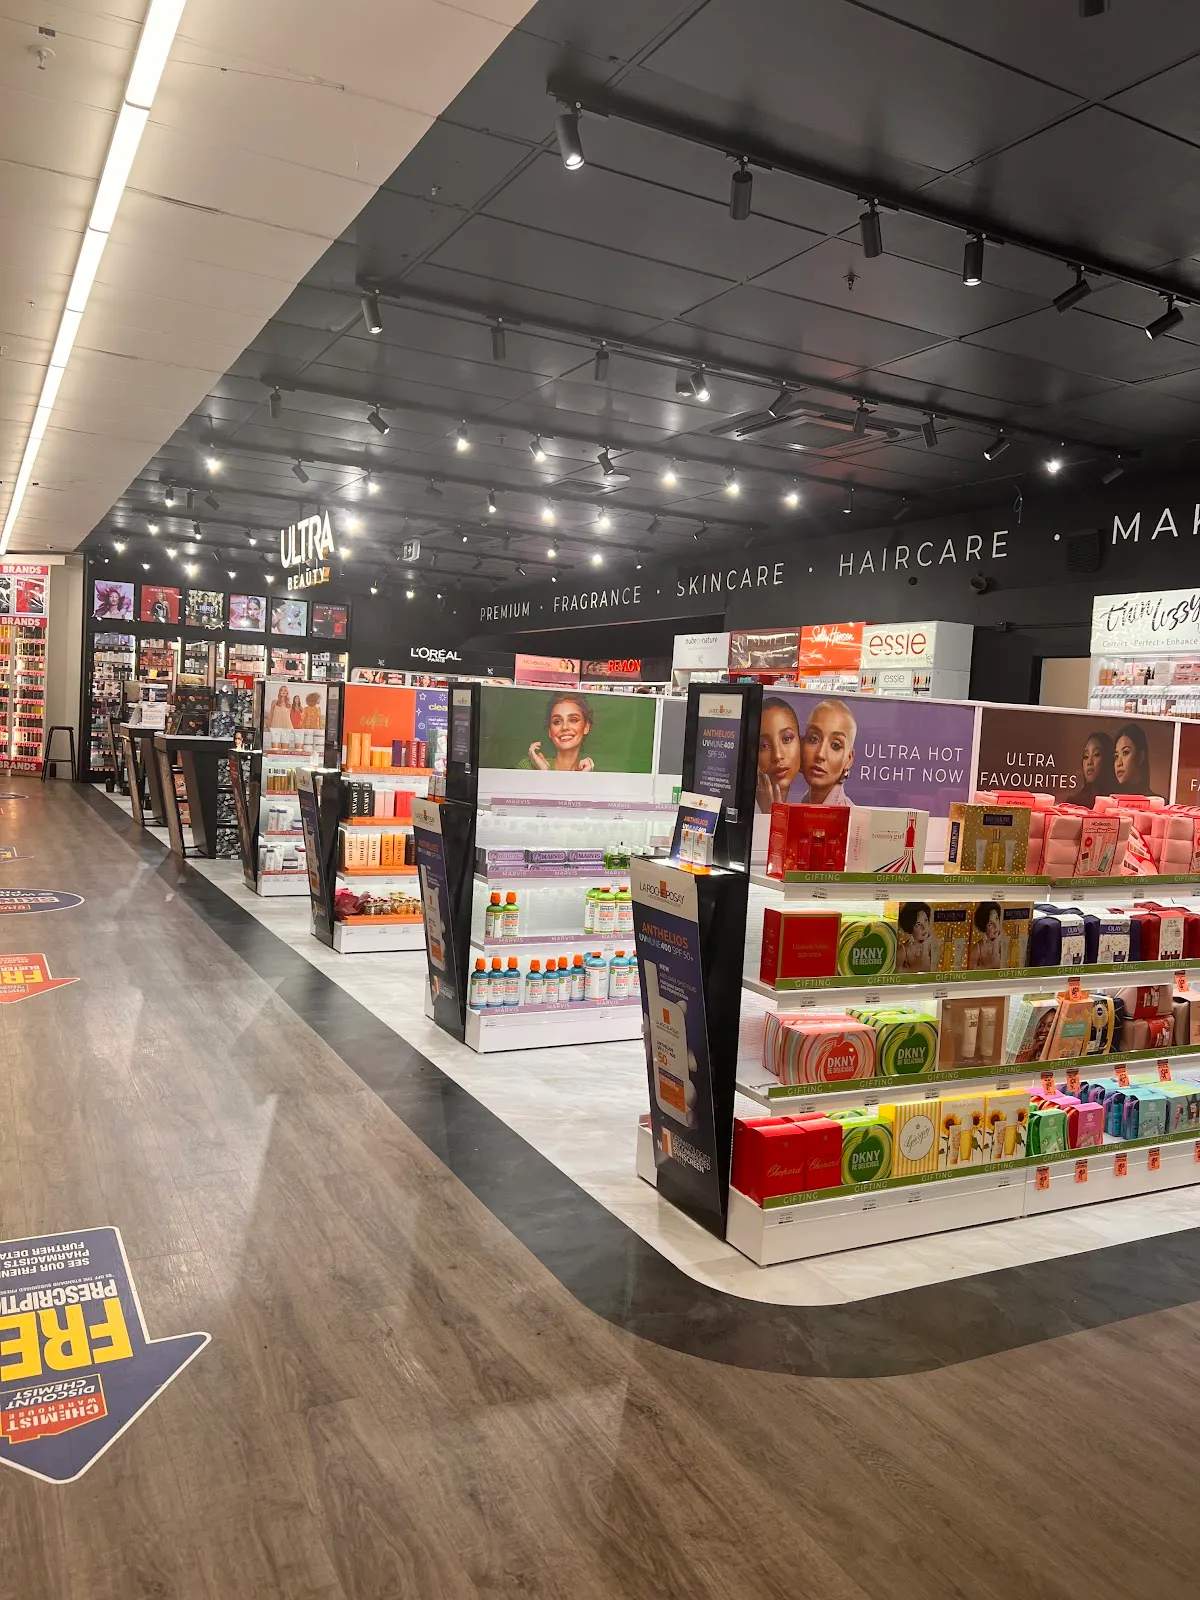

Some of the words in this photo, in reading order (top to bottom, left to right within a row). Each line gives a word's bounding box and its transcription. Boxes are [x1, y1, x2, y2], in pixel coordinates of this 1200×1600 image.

[280, 510, 334, 569] ULTRA
[839, 530, 1009, 577] HAIRCARE
[3, 565, 41, 574] BRANDS
[288, 567, 326, 591] BEAUTY
[677, 562, 785, 597] SKINCARE
[553, 586, 641, 613] FRAGRANCE
[480, 601, 530, 621] PREMIUM
[1, 617, 41, 626] BRANDS
[869, 632, 927, 656] essie
[410, 647, 462, 661] L'ORÉAL
[607, 659, 641, 673] REVLON
[864, 743, 922, 761] ULTRA
[928, 746, 964, 762] HOT
[1006, 751, 1055, 769] ULTRA
[860, 767, 917, 782] RIGHT
[922, 768, 964, 783] NOW
[980, 771, 1077, 790] FAVOURITES
[805, 873, 840, 881] GIFTING
[876, 874, 910, 882] GIFTING
[943, 875, 975, 883] GIFTING
[1007, 876, 1036, 884] GIFTING
[641, 922, 689, 949] ANTHELIOS
[852, 947, 884, 959] DKNY
[0, 970, 43, 984] FR
[867, 976, 901, 984] GIFTING
[936, 973, 967, 981] GIFTING
[998, 970, 1028, 978] GIFTING
[795, 978, 832, 988] GIFTING
[898, 1047, 926, 1059] DKNY
[827, 1055, 855, 1067] DKNY
[927, 1071, 960, 1081] GIFTING
[859, 1078, 893, 1088] GIFTING
[787, 1085, 823, 1095] GIFTING
[852, 1150, 881, 1164] DKNY
[922, 1171, 953, 1182] GIFTING
[854, 1182, 888, 1193] GIFTING
[783, 1194, 818, 1204] GIFTING
[32, 1242, 85, 1255] FURTHER
[4, 1249, 90, 1268] PHARMACISTS
[68, 1258, 90, 1267] SEE
[41, 1261, 65, 1272] OUR
[0, 1297, 133, 1382] FRE
[13, 1379, 87, 1400] CHEMIST
[6, 1384, 96, 1410] DISCOUNT
[8, 1397, 97, 1420] WAREHOUSE
[6, 1404, 101, 1431] CHEMIST
